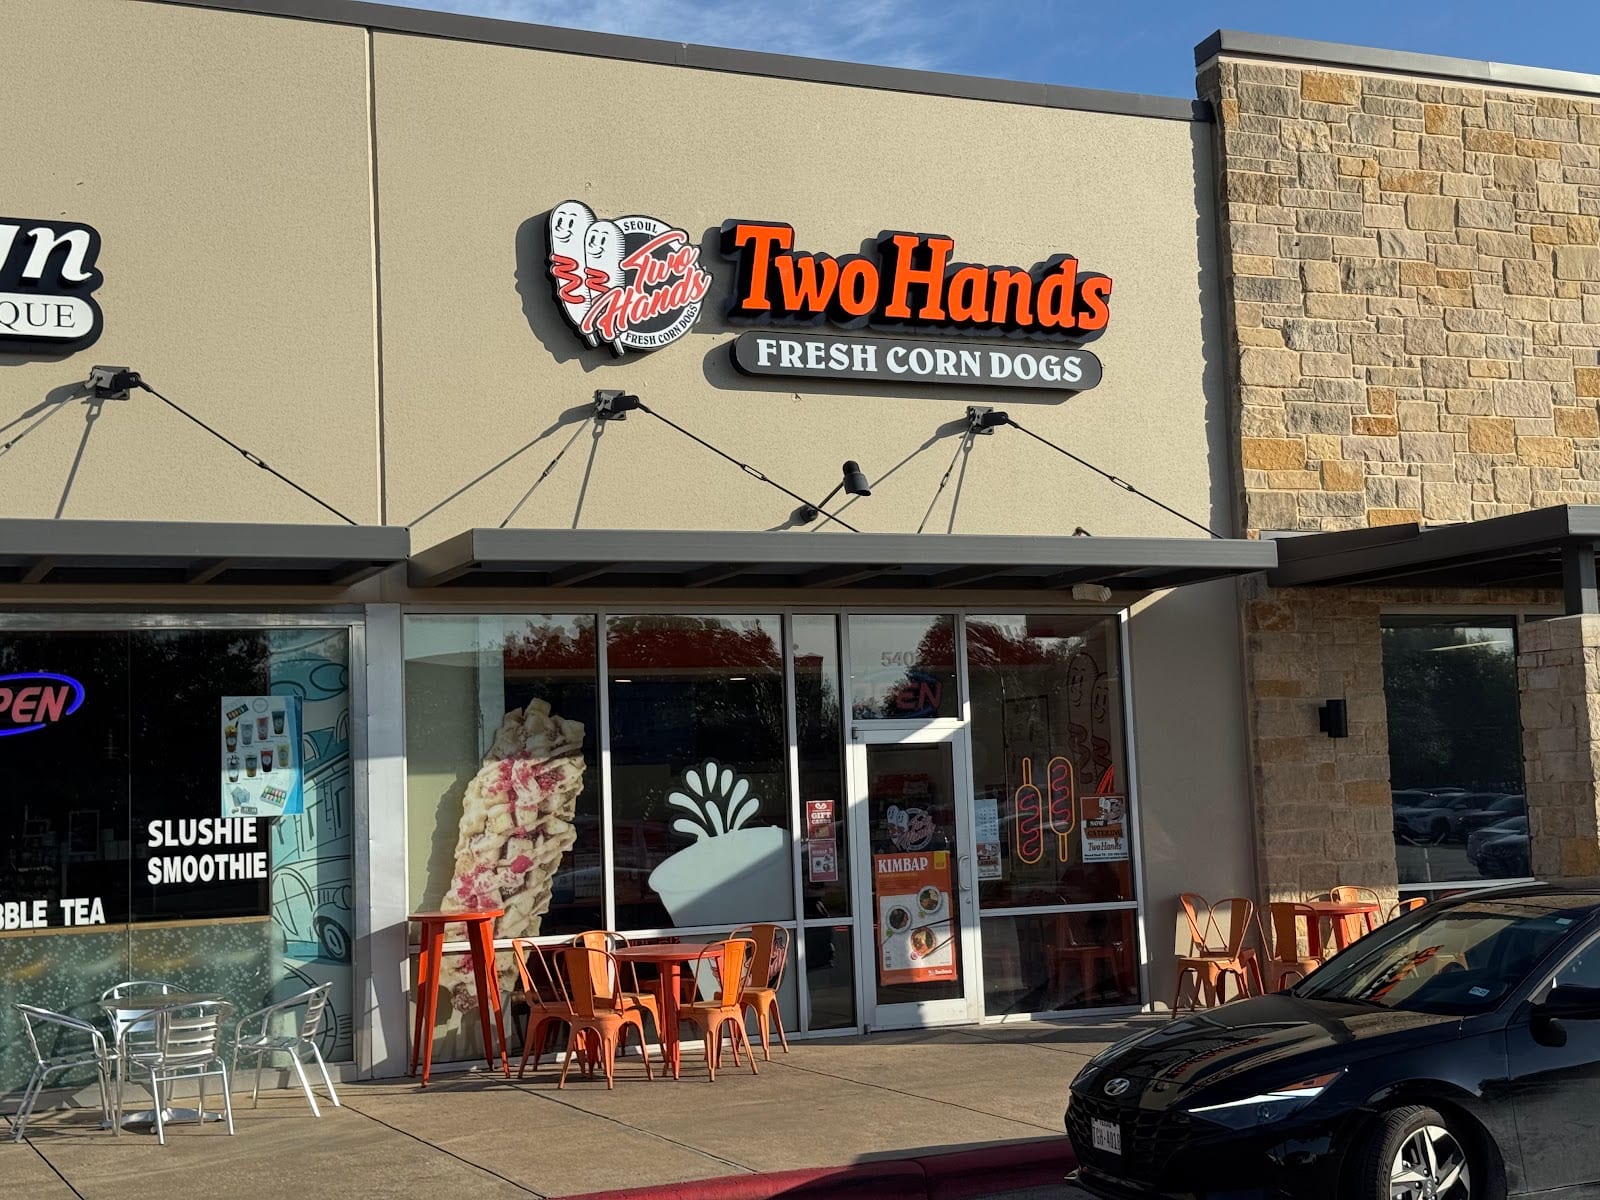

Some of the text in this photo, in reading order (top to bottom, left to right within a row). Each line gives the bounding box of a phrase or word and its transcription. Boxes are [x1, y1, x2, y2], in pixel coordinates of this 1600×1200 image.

[623, 220, 658, 234] SEOUL
[620, 230, 700, 292] Two
[735, 224, 1113, 330] Two Hands
[0, 300, 76, 332] QUE
[582, 266, 712, 340] Hands
[625, 304, 699, 346] FRESH CORN DOGS
[756, 338, 1083, 384] FRESH CORN DOGS
[147, 816, 257, 848] SLUSHIE
[811, 811, 832, 820] GIFT
[147, 852, 268, 885] SMOOTHIE
[878, 857, 929, 873] KIMBAP
[0, 896, 106, 930] BLE TEA
